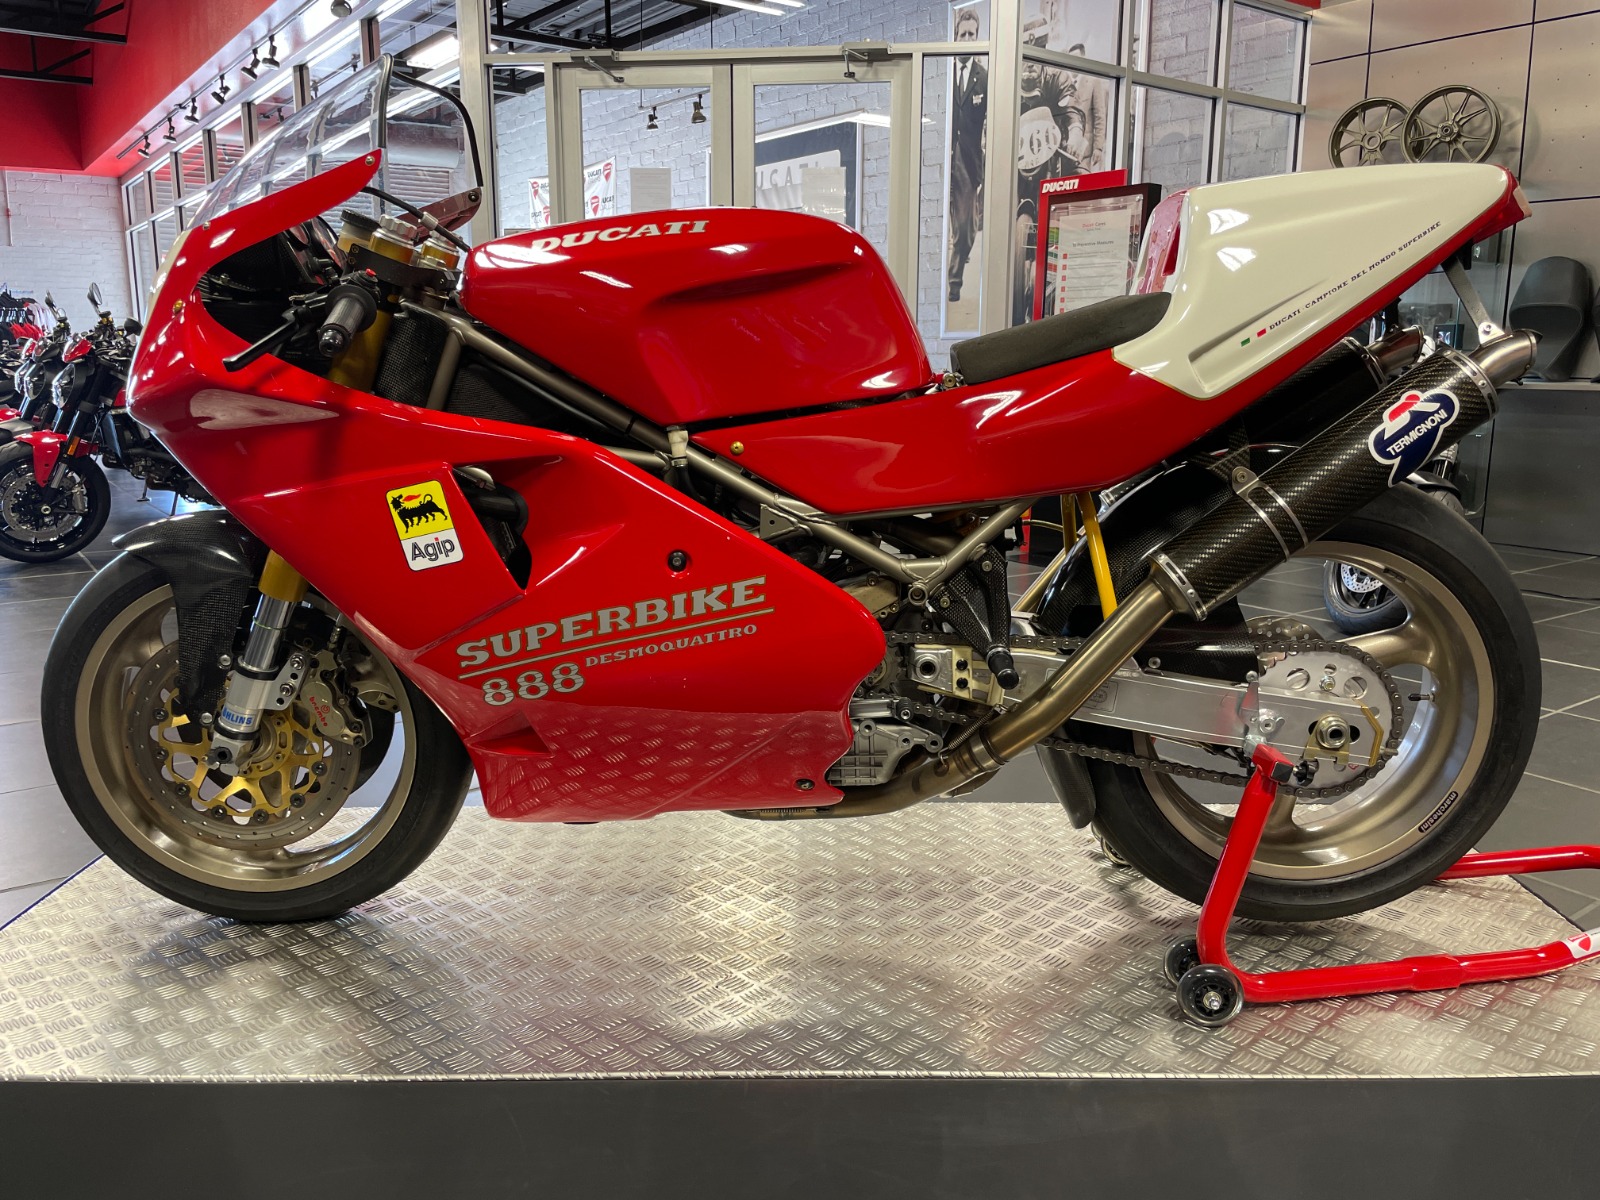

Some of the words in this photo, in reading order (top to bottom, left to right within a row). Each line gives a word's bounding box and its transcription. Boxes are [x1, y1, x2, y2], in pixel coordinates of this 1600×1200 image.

[1041, 179, 1080, 194] DUCATI
[531, 220, 710, 251] DUCATI
[1269, 308, 1301, 331] DUCATI
[1305, 280, 1349, 309] CAMPIONE
[1350, 269, 1368, 282] DEL
[1369, 251, 1397, 272] MONDO
[1398, 220, 1442, 253] SUPERBIKE
[1386, 408, 1448, 456] TERMIGNONI
[411, 536, 456, 562] Agip
[456, 575, 767, 669] SUPERBIKE
[585, 623, 758, 668] DESMOQUATTRO
[482, 662, 585, 707] 888
[309, 696, 328, 728] brembo
[1420, 791, 1457, 833] marchesini
